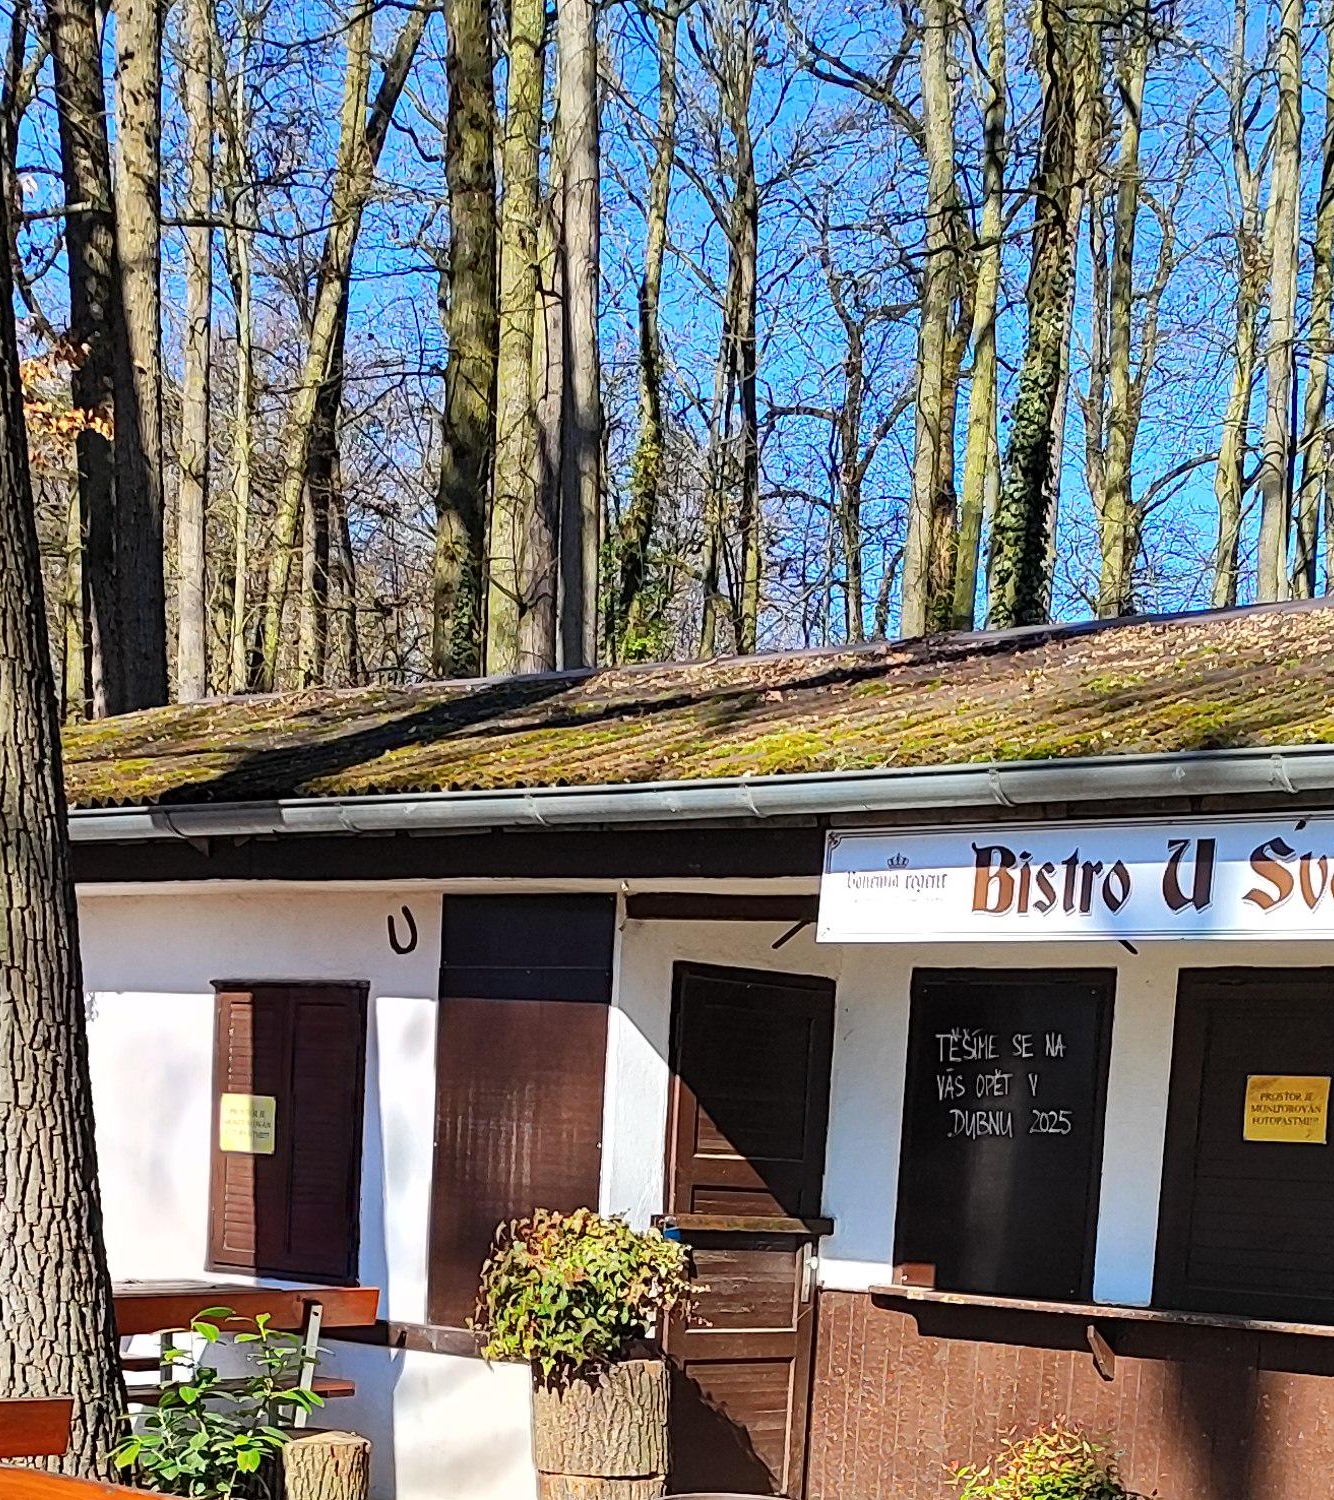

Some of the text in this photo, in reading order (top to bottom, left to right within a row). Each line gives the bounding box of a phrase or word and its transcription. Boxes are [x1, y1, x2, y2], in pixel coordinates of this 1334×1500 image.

[971, 842, 1132, 915] Bistro
[1162, 838, 1216, 914] U
[935, 1027, 1067, 1062] TĚŠÍME SE NA
[936, 1068, 1038, 1101] VÁS OPĚT V
[948, 1109, 1073, 1139] DUBNU 2025
